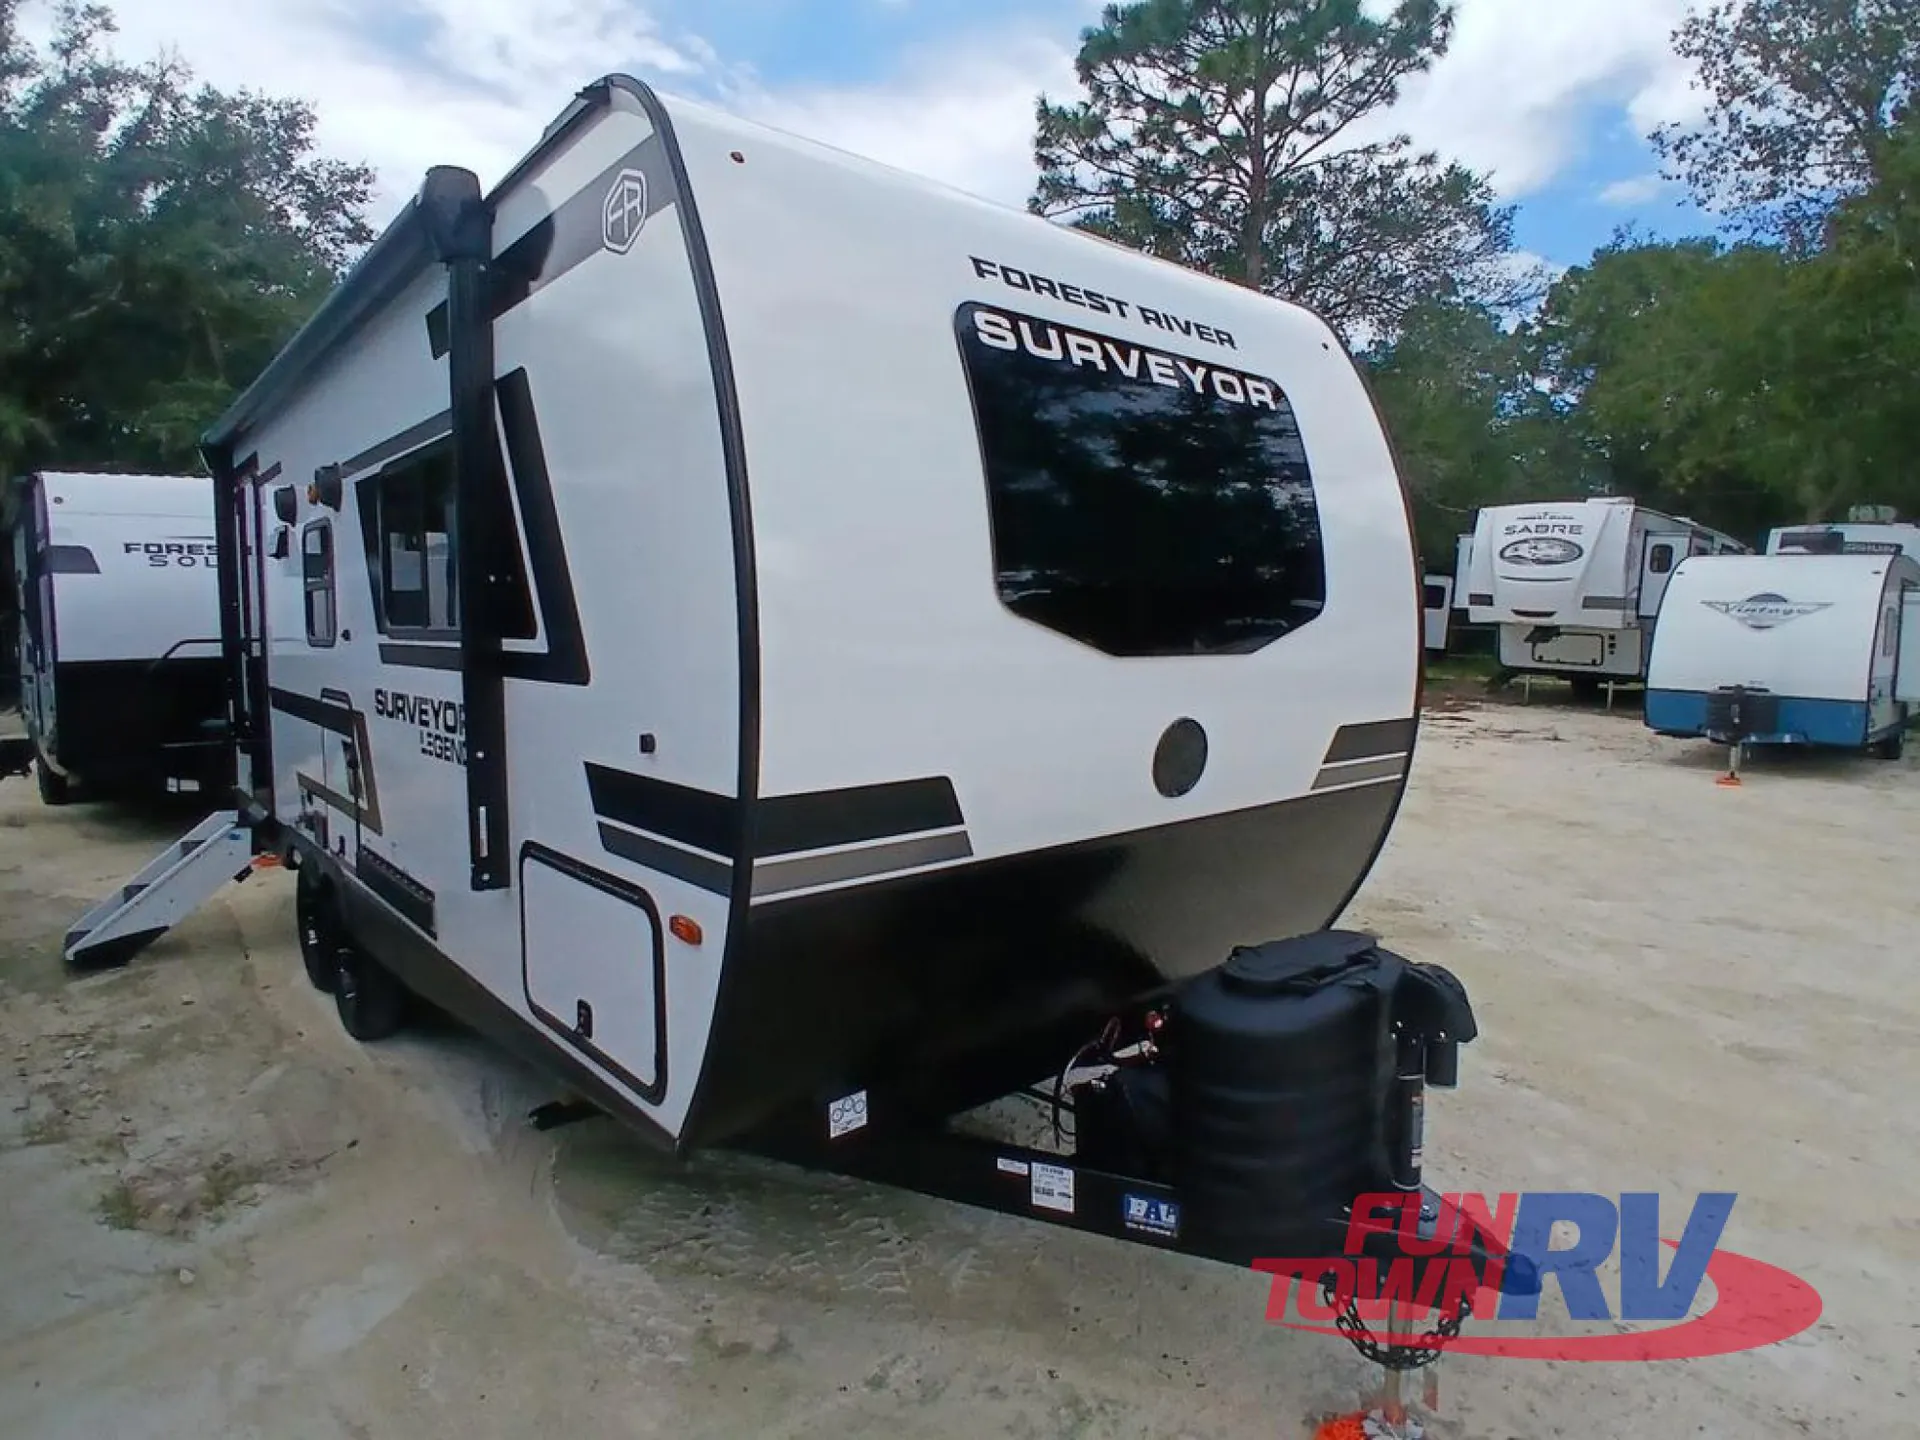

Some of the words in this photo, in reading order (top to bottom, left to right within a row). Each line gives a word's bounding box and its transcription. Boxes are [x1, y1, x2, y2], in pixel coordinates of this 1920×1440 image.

[968, 255, 1130, 318] FOREST
[1136, 305, 1239, 350] RIVER
[972, 310, 1277, 411] SURVEYOR
[122, 543, 220, 556] FORES
[148, 554, 219, 568] SOL
